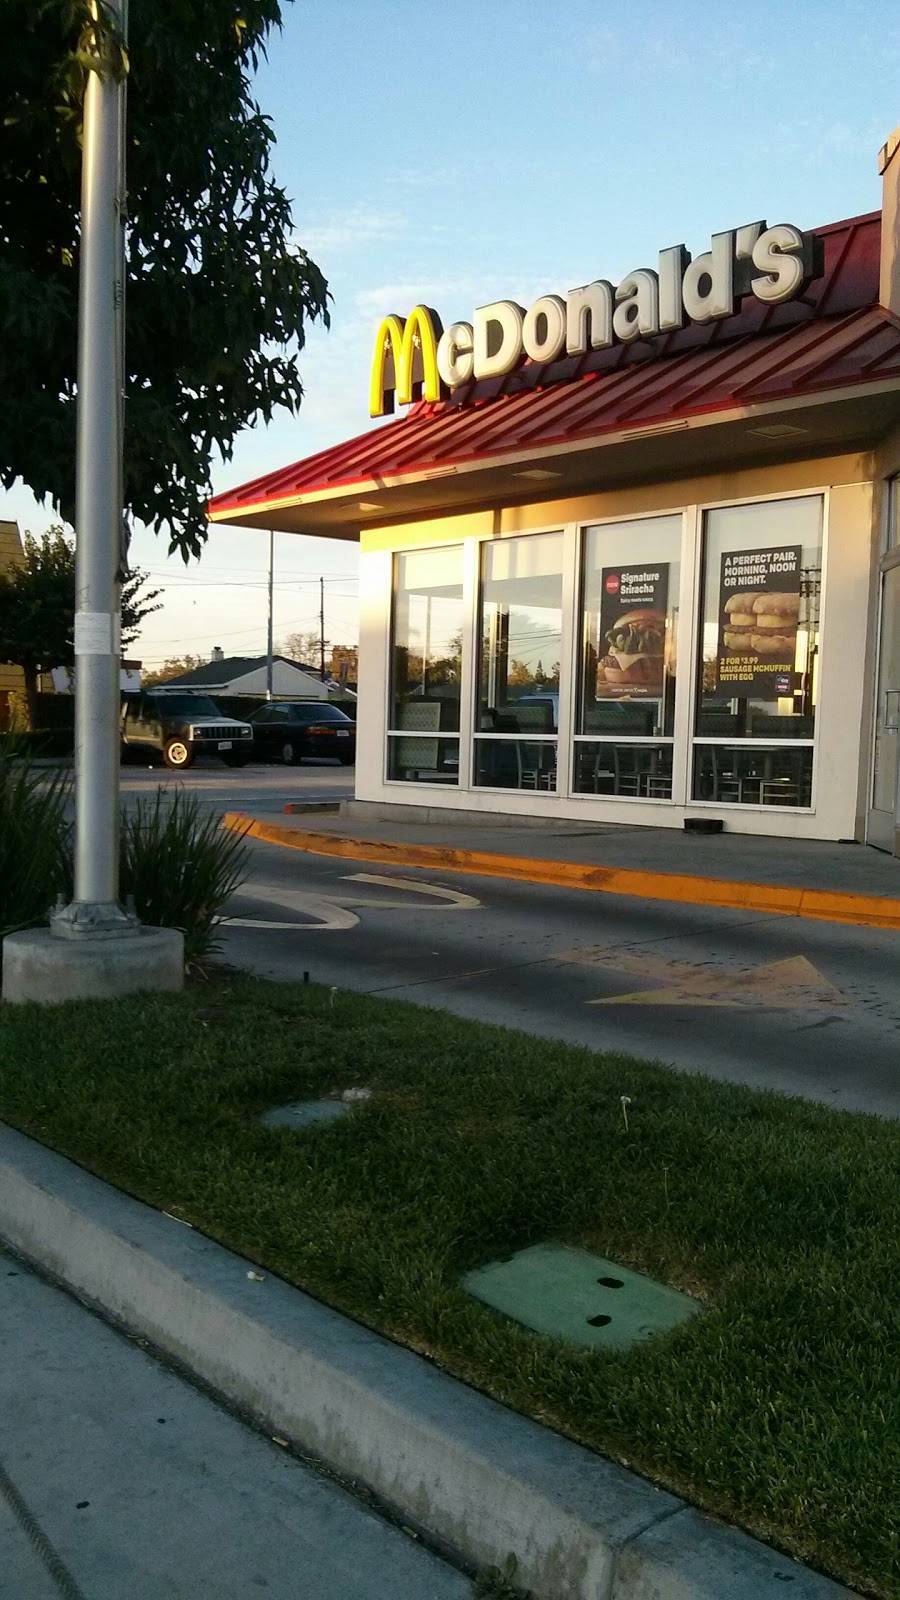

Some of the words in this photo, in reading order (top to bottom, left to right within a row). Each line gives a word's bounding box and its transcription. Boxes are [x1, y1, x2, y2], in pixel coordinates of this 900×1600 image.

[369, 219, 809, 418] McDonald's
[724, 556, 732, 566] A
[733, 553, 772, 565] PERFECT
[773, 551, 797, 562] PAIR.
[724, 564, 768, 577] MORNING,
[769, 562, 796, 573] NOON
[620, 572, 660, 584] Signature
[724, 576, 737, 587] OR
[738, 574, 766, 586] NIGHT.
[620, 583, 654, 595] Sriracha
[726, 657, 740, 665] FOR
[720, 665, 752, 673] SAUSAGE
[720, 673, 738, 681] WITH
[739, 673, 754, 681] EGG
